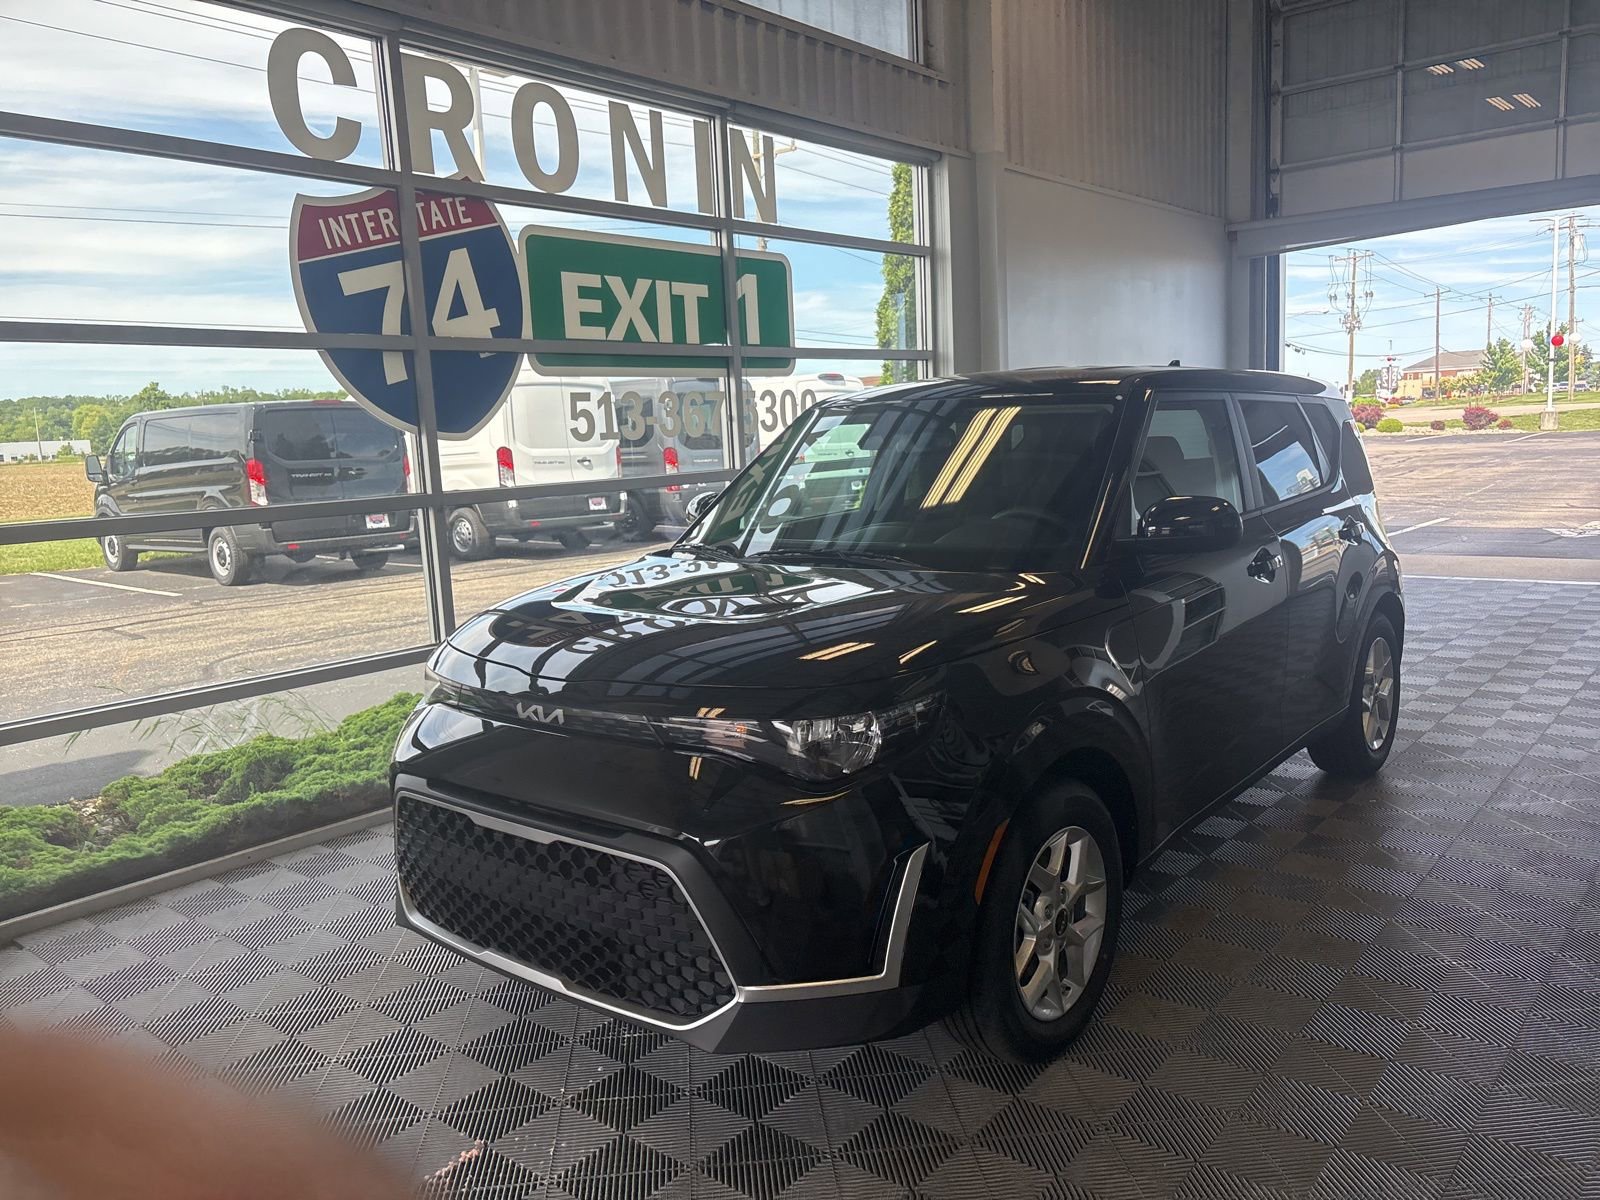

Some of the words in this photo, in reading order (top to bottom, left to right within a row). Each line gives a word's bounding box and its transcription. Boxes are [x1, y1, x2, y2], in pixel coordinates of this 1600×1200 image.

[267, 27, 777, 224] CRONIN
[319, 197, 472, 250] INTERTATE
[337, 247, 501, 386] 74
[560, 271, 709, 346] EXIT
[735, 273, 761, 345] 1
[516, 701, 565, 725] KIA
